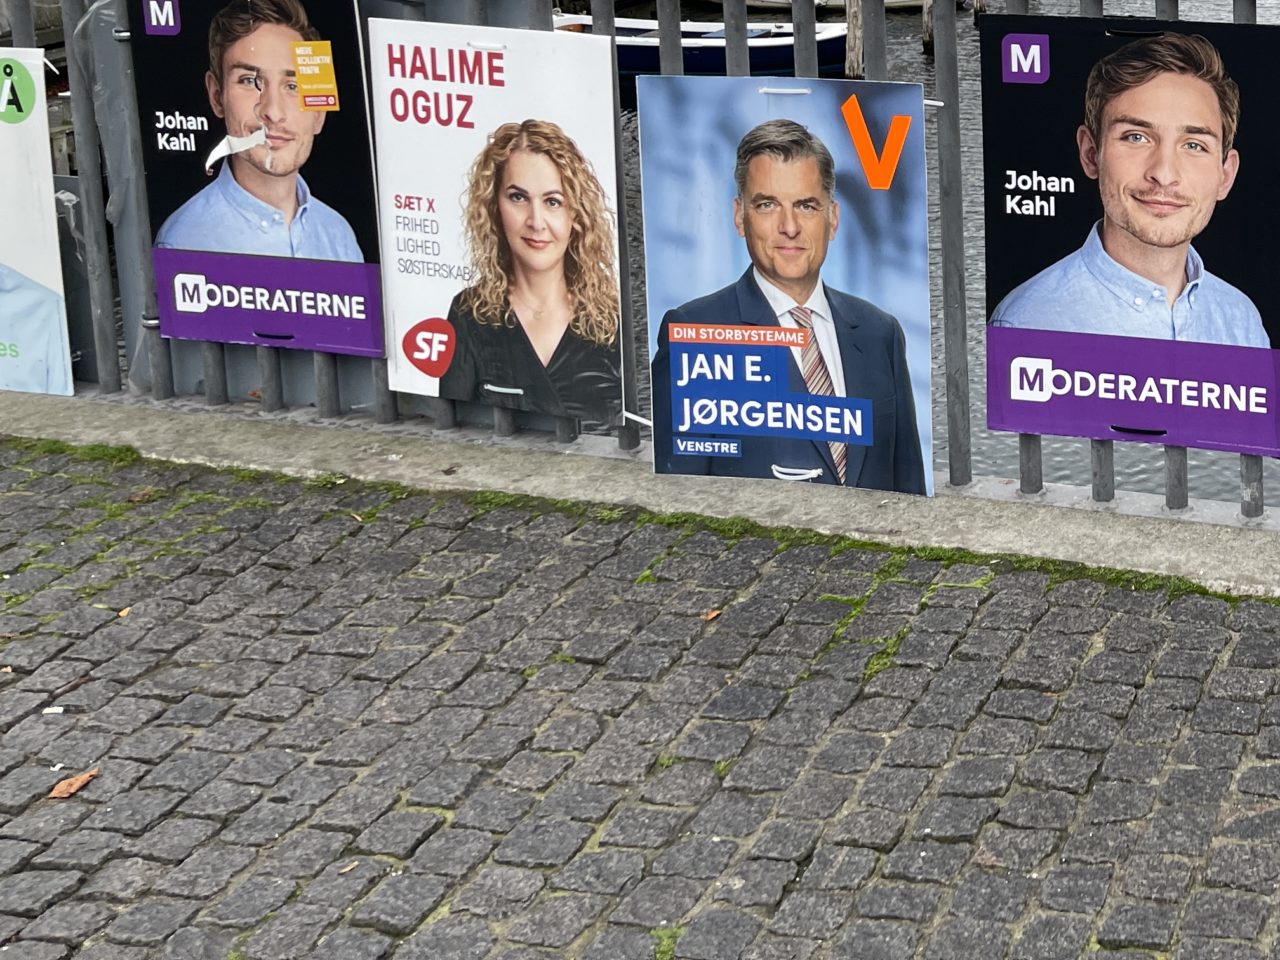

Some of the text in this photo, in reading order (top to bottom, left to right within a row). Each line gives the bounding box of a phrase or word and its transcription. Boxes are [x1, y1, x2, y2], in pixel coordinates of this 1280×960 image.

[149, 0, 175, 27] M
[387, 43, 505, 87] HALIME
[1011, 44, 1041, 74] M
[390, 87, 475, 129] OGUZ
[155, 111, 209, 131] Johan
[157, 133, 196, 152] Kahl
[841, 93, 912, 190] V
[1004, 170, 1075, 194] Johan
[394, 194, 436, 213] SÆT X
[1005, 195, 1056, 217] Kahl
[395, 215, 439, 235] FRIHED
[396, 237, 440, 256] LIGHED
[397, 258, 472, 281] SØSTERSKAB
[174, 273, 366, 320] MODERATERNE
[413, 331, 449, 362] SF
[673, 327, 804, 344] DIN STORBYSTEMME
[677, 352, 772, 387] JAN E.
[1010, 357, 1268, 413] MODERATERNE
[679, 397, 863, 437] JØRGENSEN
[677, 440, 739, 454] VENSTRE
